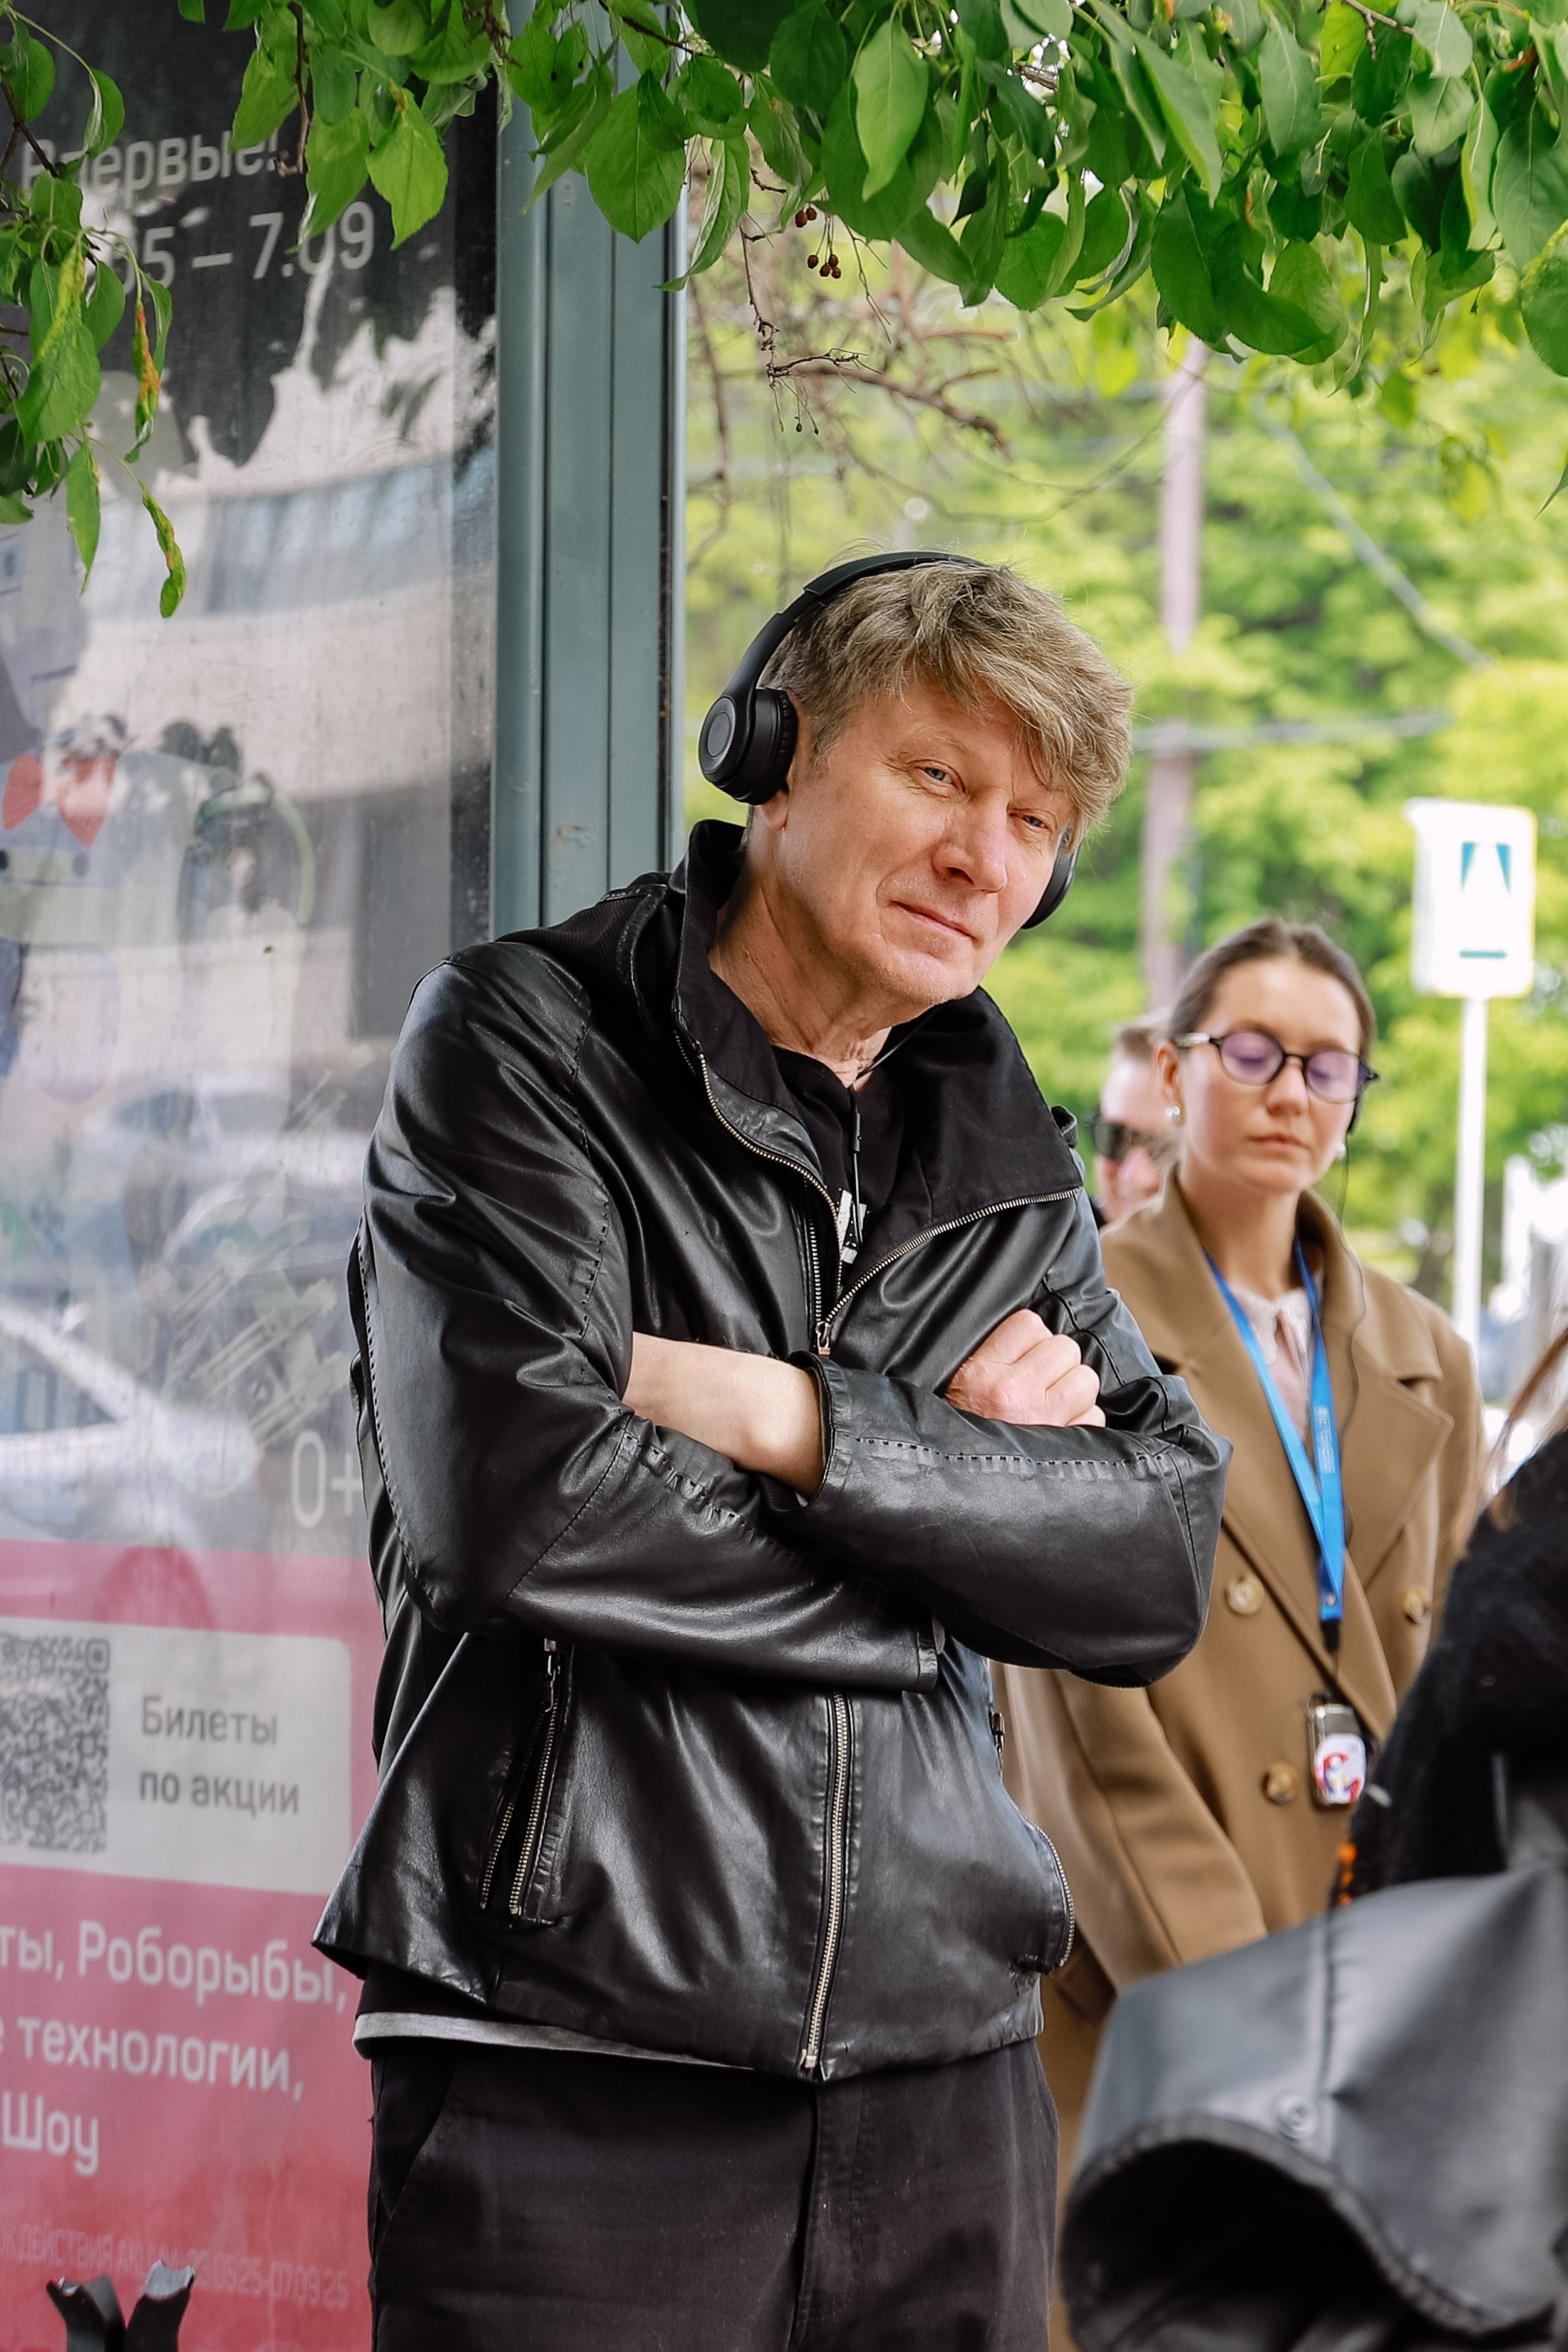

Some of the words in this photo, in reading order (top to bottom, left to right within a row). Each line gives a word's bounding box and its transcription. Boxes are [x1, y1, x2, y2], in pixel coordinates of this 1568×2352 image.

[249, 200, 374, 279] 7.09
[291, 1429, 361, 1528] 0+
[143, 1694, 277, 1745] Билеты
[140, 1770, 180, 1804] по
[192, 1774, 299, 1817] акции
[78, 1919, 347, 2014] Роборыбы,
[17, 2016, 304, 2102] технологии,
[3, 2090, 99, 2176] Шоу
